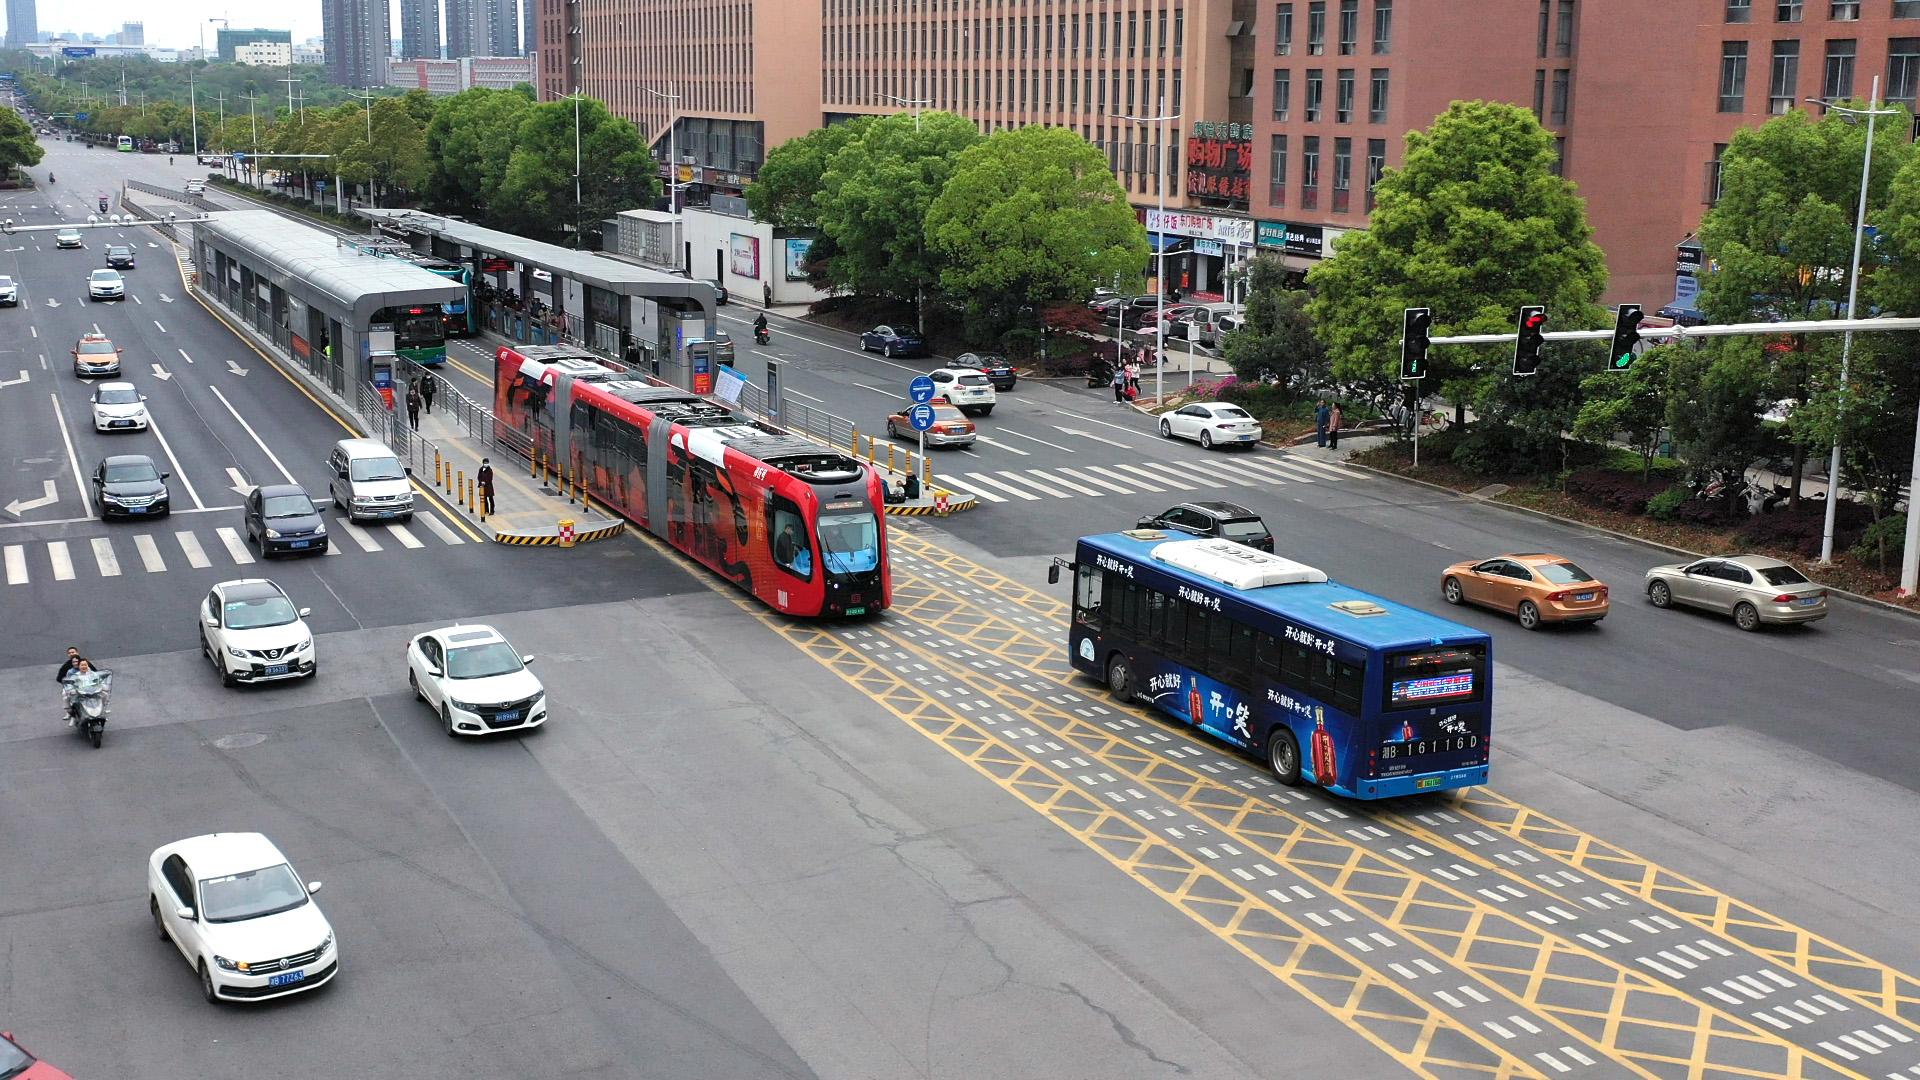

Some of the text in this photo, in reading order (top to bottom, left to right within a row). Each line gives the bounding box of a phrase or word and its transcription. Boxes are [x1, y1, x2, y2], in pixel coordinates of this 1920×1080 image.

[1149, 673, 1181, 692] 开心就好
[1209, 690, 1251, 738] 开口笑
